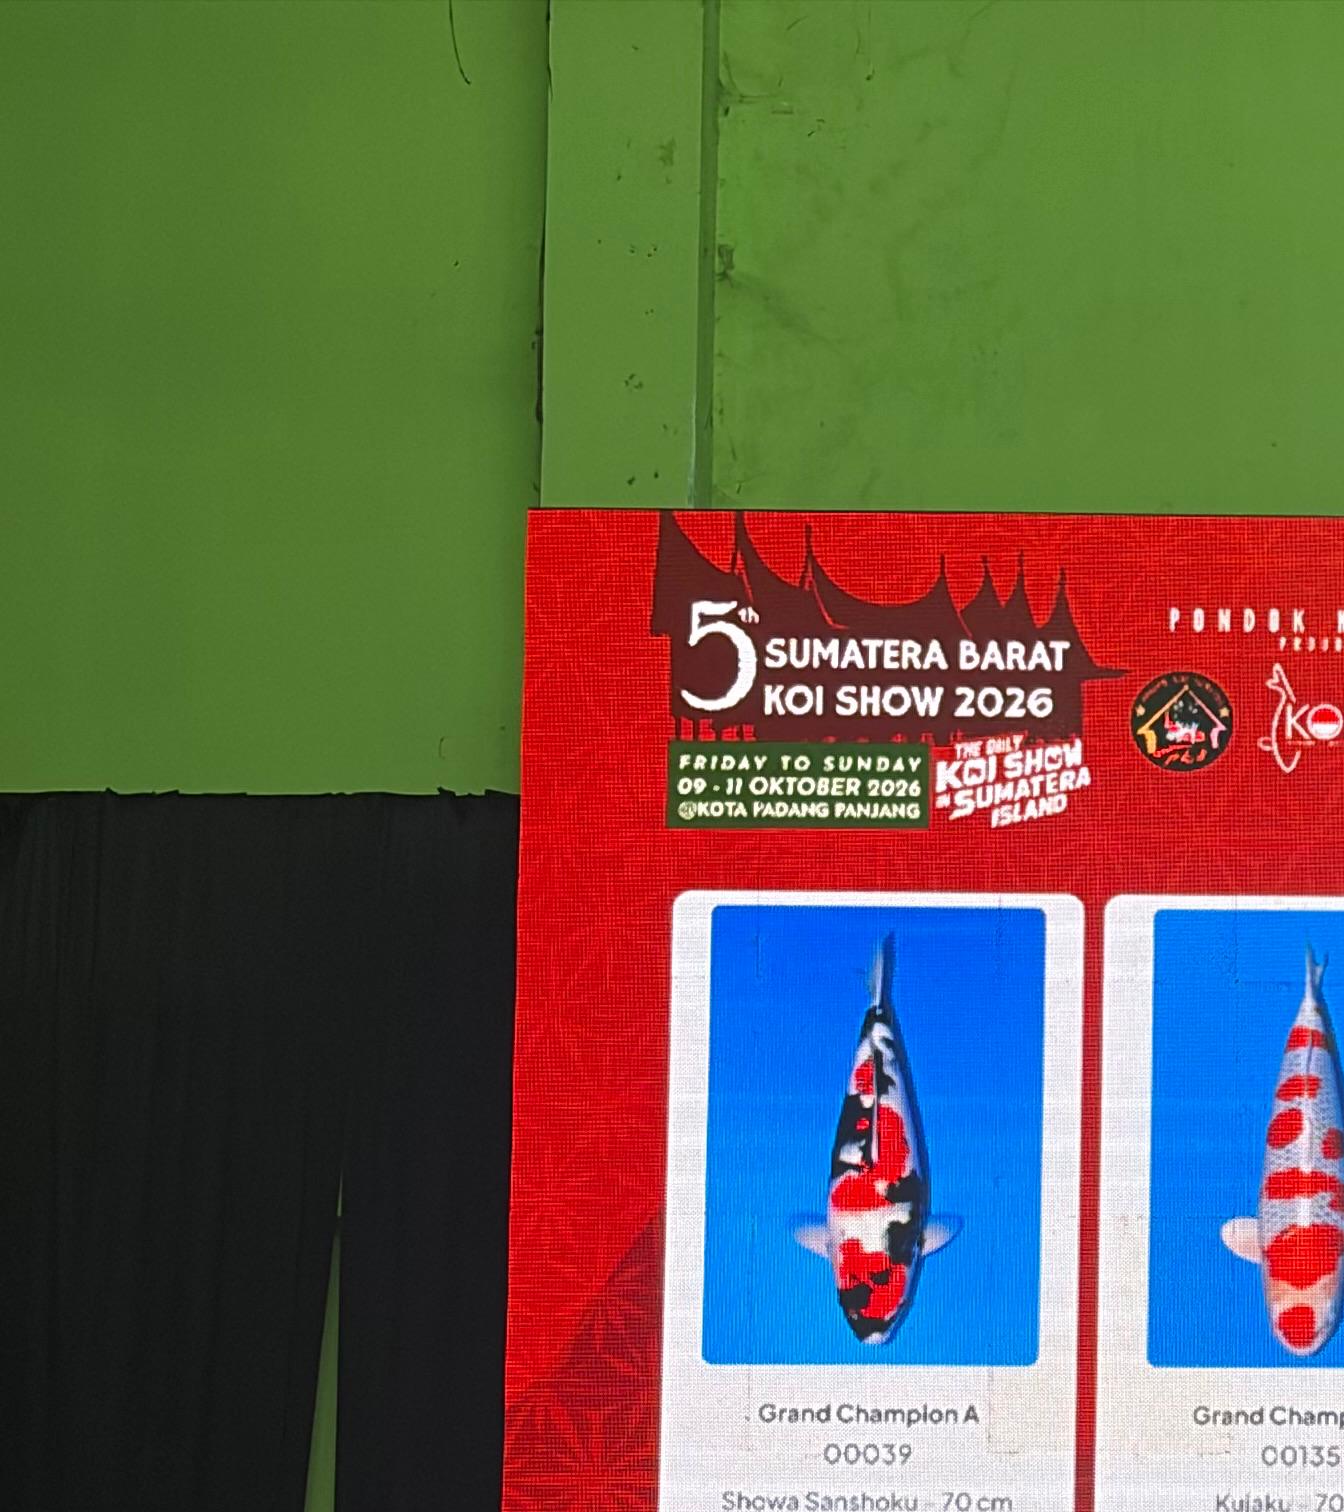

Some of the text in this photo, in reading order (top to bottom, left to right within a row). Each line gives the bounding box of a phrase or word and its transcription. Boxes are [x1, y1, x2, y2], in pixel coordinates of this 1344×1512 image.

[1169, 607, 1305, 632] PONDOK
[765, 638, 1071, 672] SUMATERA BARAT
[763, 684, 1053, 718] KOI SHOW 2026
[954, 741, 983, 760] THE
[678, 755, 922, 772] FRIDAY TO SUNDAY
[936, 738, 1082, 793] KOI SHOW
[677, 778, 707, 795] 09
[726, 778, 743, 795] 11
[749, 777, 861, 796] OKTOBER
[867, 779, 921, 797] 2026
[949, 767, 1092, 820] SUMATERA
[677, 801, 921, 820] @KOTA PADANG PANJANG
[991, 794, 1068, 828] ISLAND
[758, 1403, 979, 1427] Grand Champion A
[1193, 1406, 1264, 1425] Grand
[823, 1443, 912, 1465] 00039
[1261, 1446, 1341, 1466] 00135
[721, 1491, 799, 1512] Showa
[805, 1492, 918, 1512] Sanshoku
[942, 1492, 972, 1512] 70
[976, 1497, 1013, 1512] cm
[1315, 1495, 1344, 1512] 70
